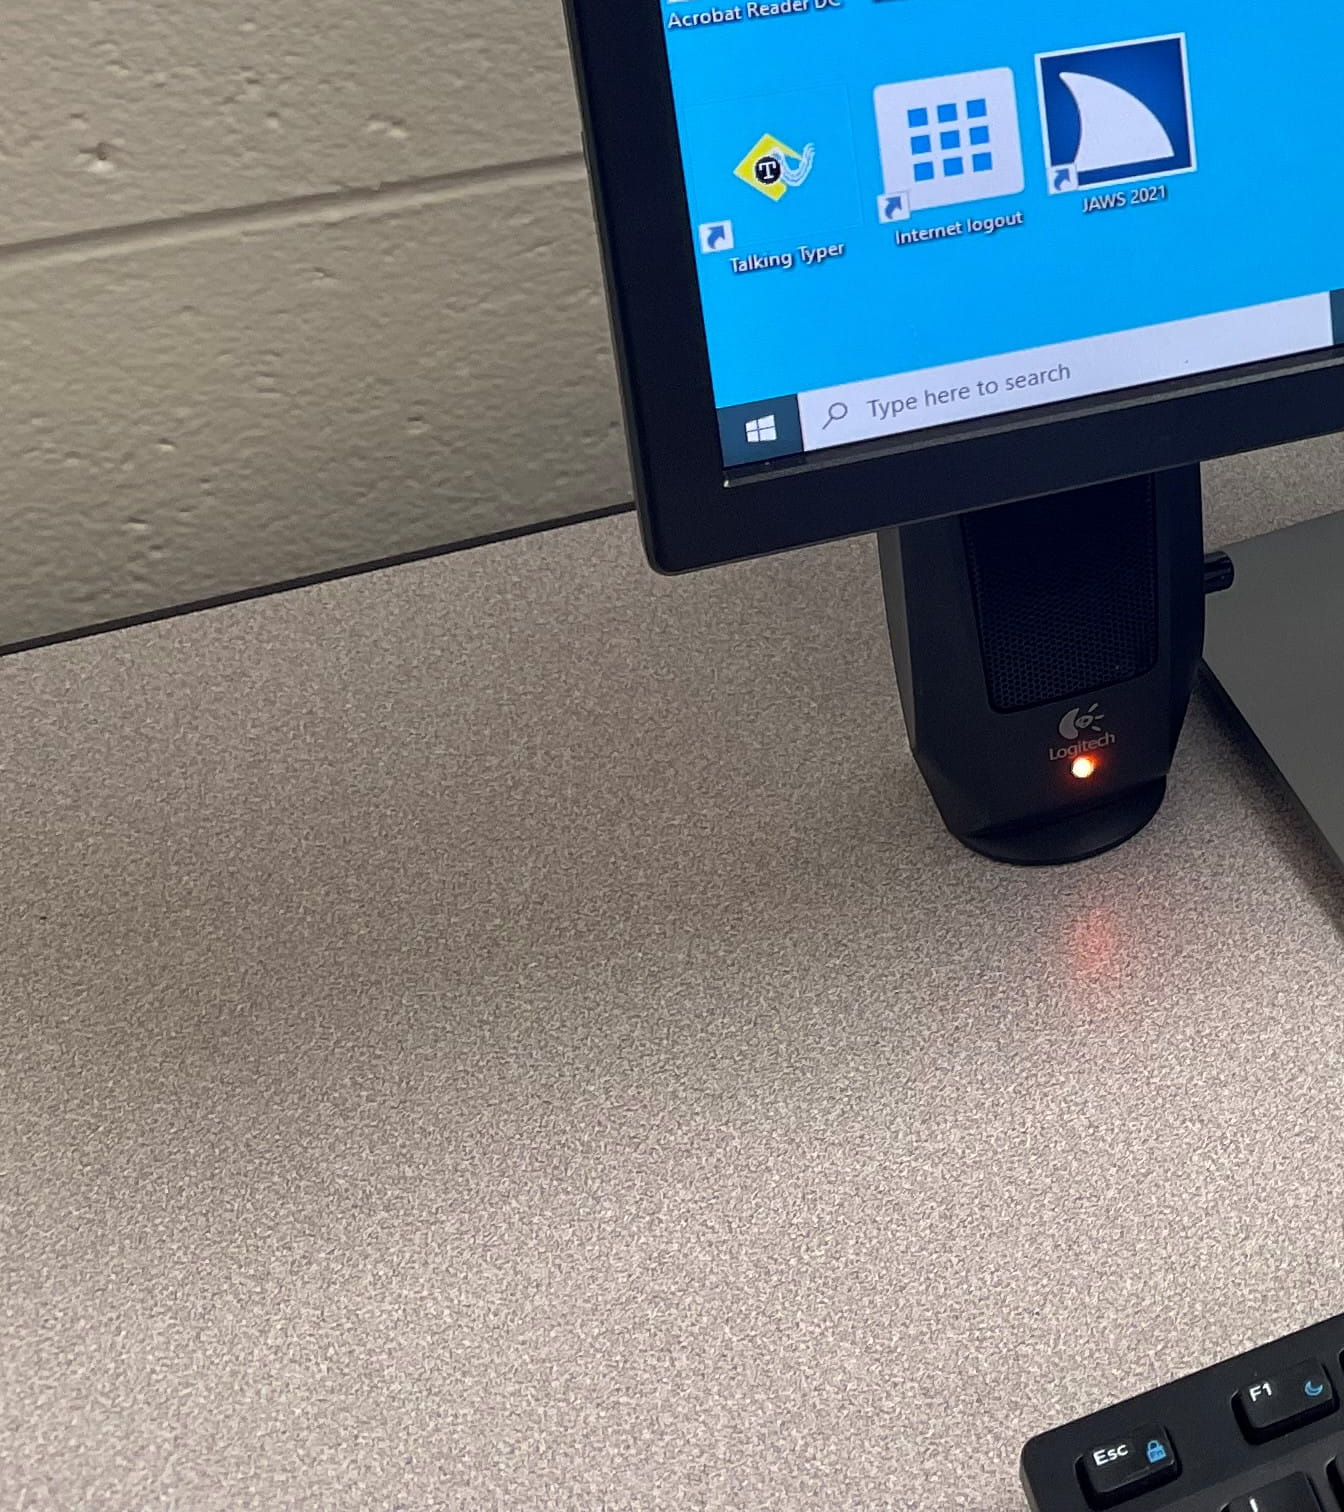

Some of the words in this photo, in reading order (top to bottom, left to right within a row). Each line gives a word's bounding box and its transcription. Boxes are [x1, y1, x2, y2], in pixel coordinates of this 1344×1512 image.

[667, 3, 742, 29] Acrobat
[1082, 190, 1127, 214] JAWS
[1130, 185, 1167, 205] 2021
[894, 217, 963, 245] Internet
[966, 211, 1024, 240] logout
[729, 249, 792, 275] Talking
[797, 242, 846, 266] Typer
[867, 394, 919, 424] Type
[924, 382, 972, 408] here
[976, 376, 1000, 397] to
[1003, 361, 1072, 393] search
[1049, 731, 1116, 761] Logitech
[1250, 1382, 1273, 1403] F1
[1093, 1443, 1130, 1468] Esc
